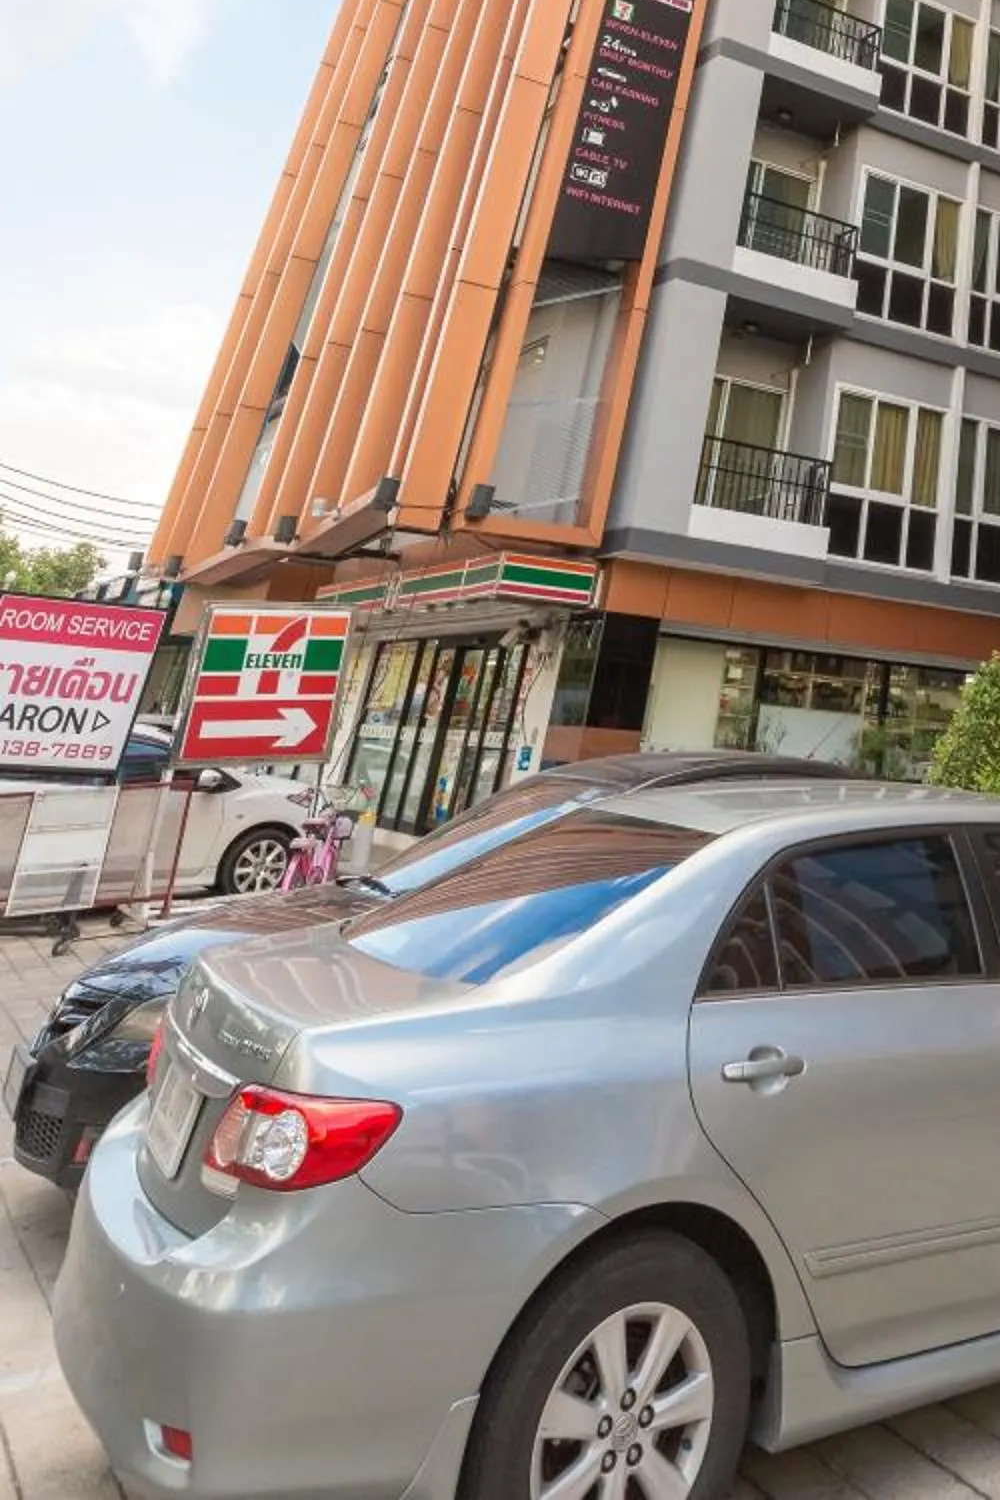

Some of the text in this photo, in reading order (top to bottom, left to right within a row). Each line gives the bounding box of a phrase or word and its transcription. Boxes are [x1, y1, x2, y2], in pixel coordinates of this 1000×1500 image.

[0, 608, 155, 641] ROOM SERVICE
[0, 657, 138, 704] ายเดือน
[0, 703, 89, 735] ARON
